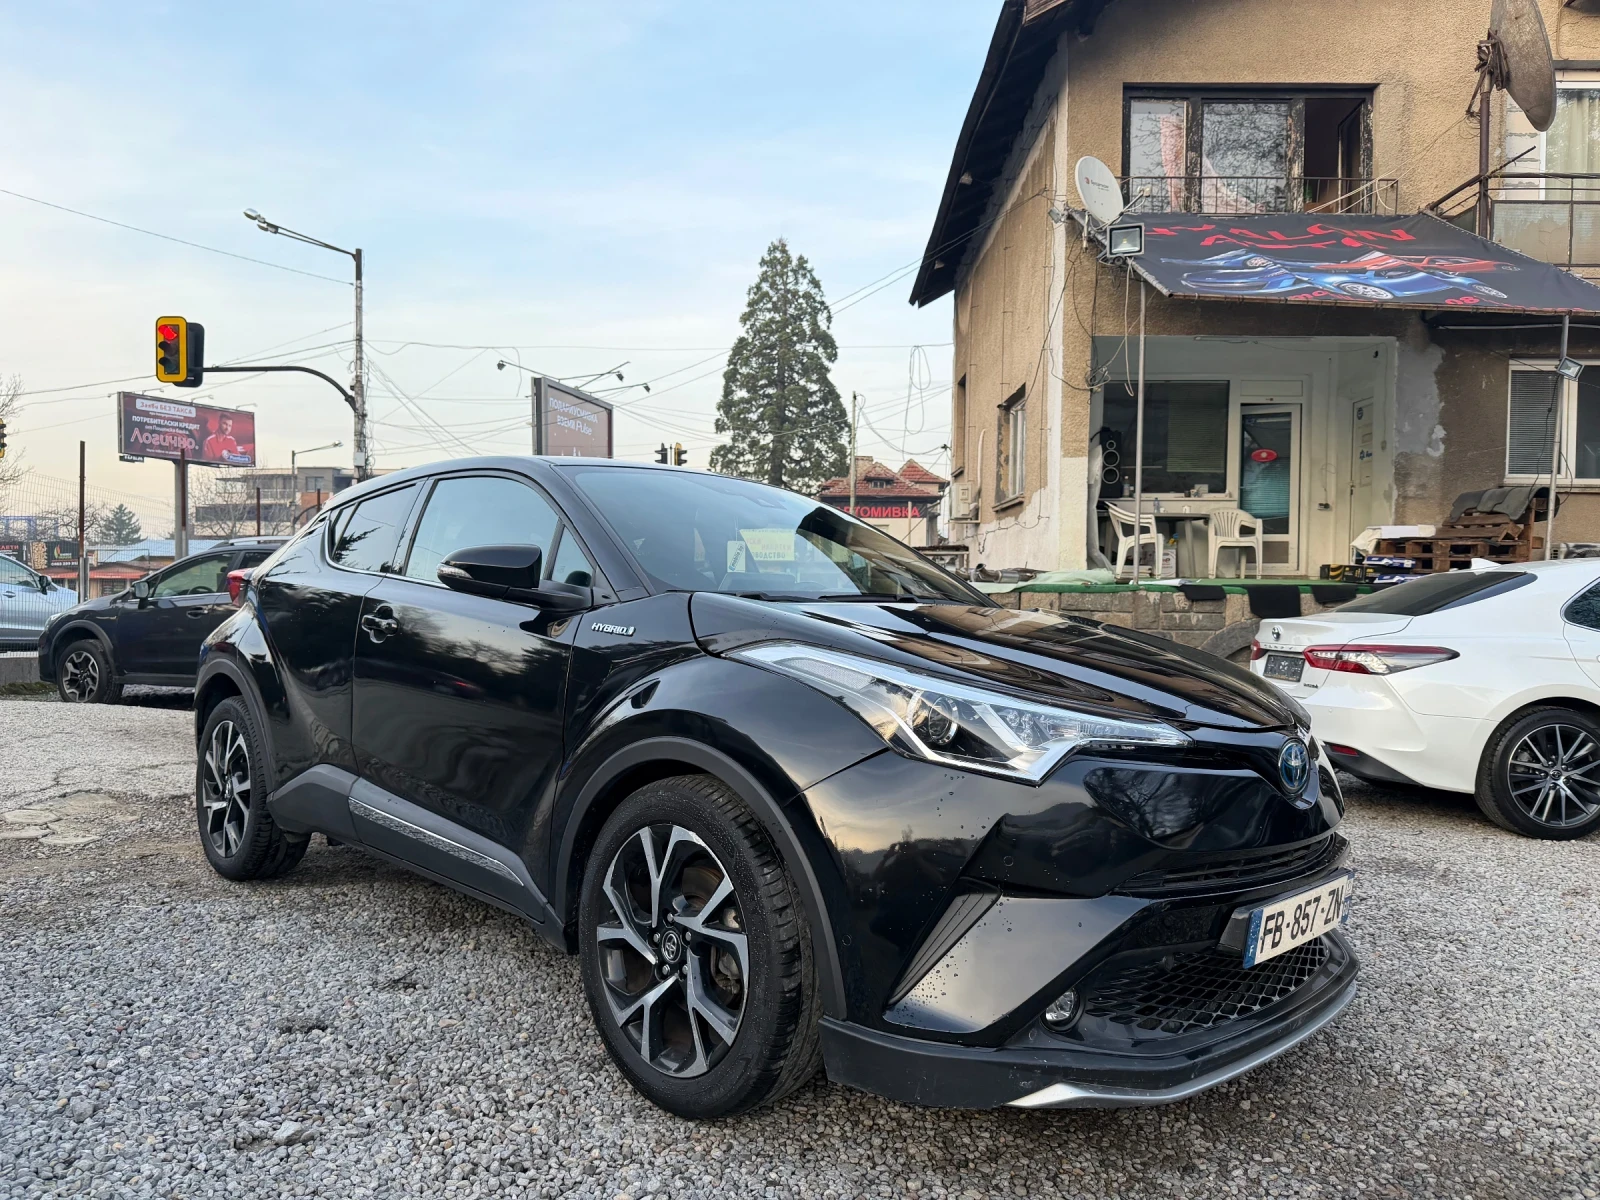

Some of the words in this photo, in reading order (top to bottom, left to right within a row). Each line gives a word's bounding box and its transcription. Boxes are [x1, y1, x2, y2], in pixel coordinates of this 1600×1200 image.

[173, 406, 194, 415] ТАКСА
[178, 421, 200, 430] КРЕДИТ
[575, 420, 592, 435] Pulse
[838, 506, 920, 518] ВТОМИВКА
[591, 622, 627, 634] HYBRID
[1259, 884, 1345, 955] FB-857-ZN
